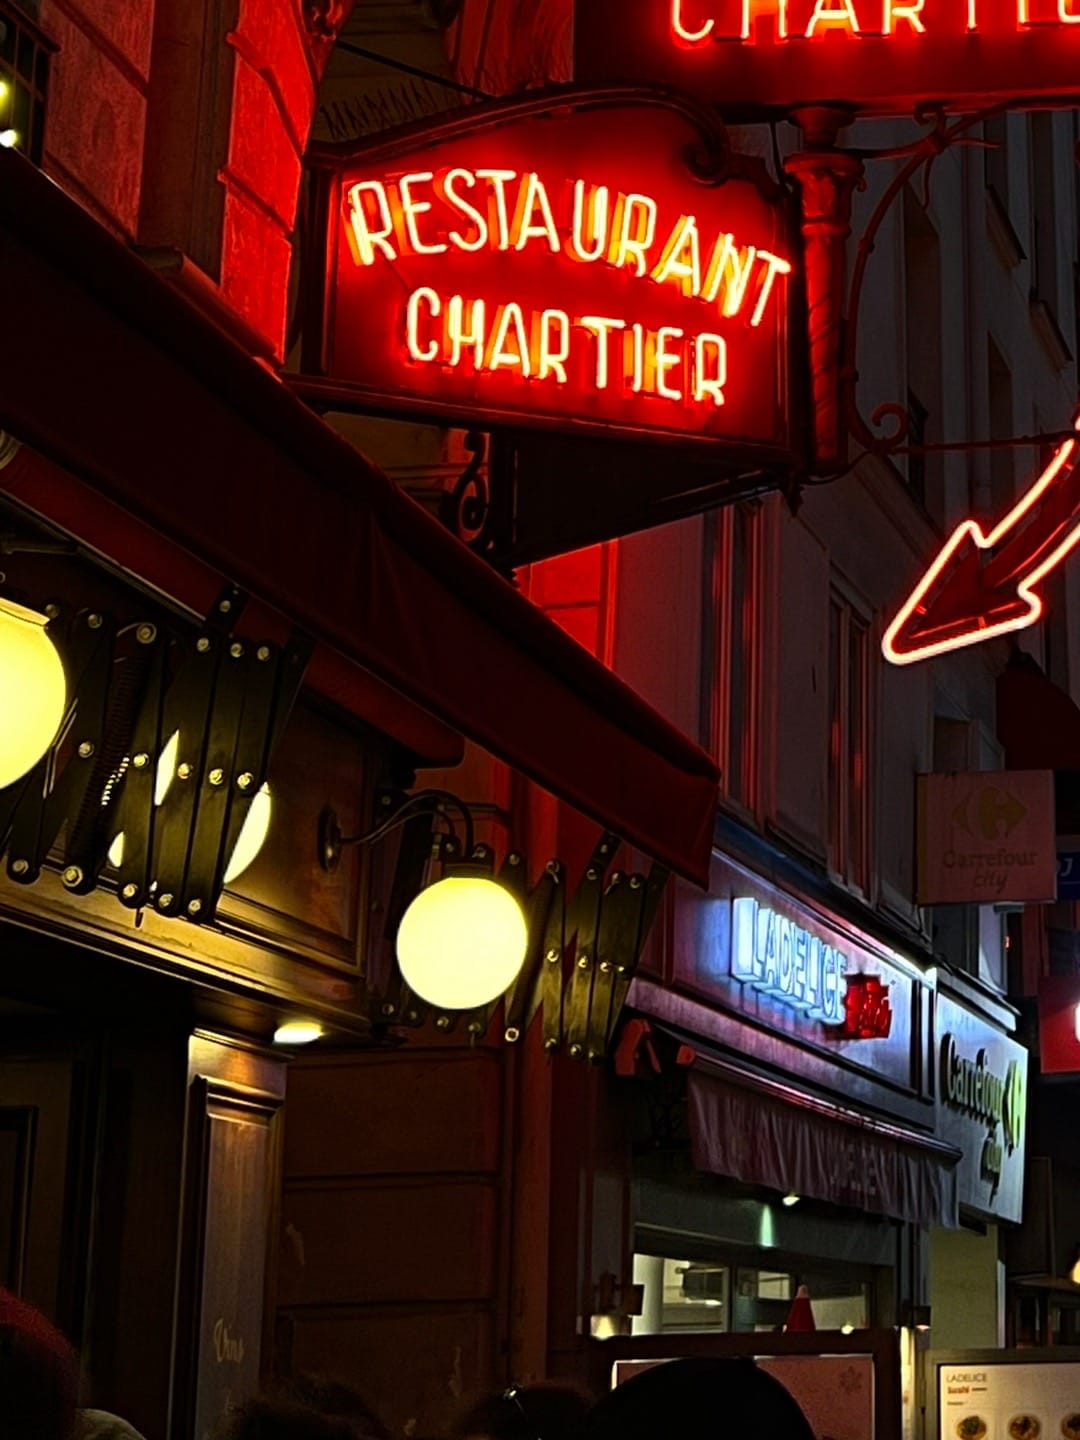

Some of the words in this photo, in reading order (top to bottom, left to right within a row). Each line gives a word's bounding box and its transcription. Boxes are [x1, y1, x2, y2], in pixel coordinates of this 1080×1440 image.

[347, 166, 792, 330] RESTAURANT
[404, 285, 729, 407] CHARTIER
[942, 848, 1038, 869] Carrefour
[946, 1373, 988, 1383] LADELICE
